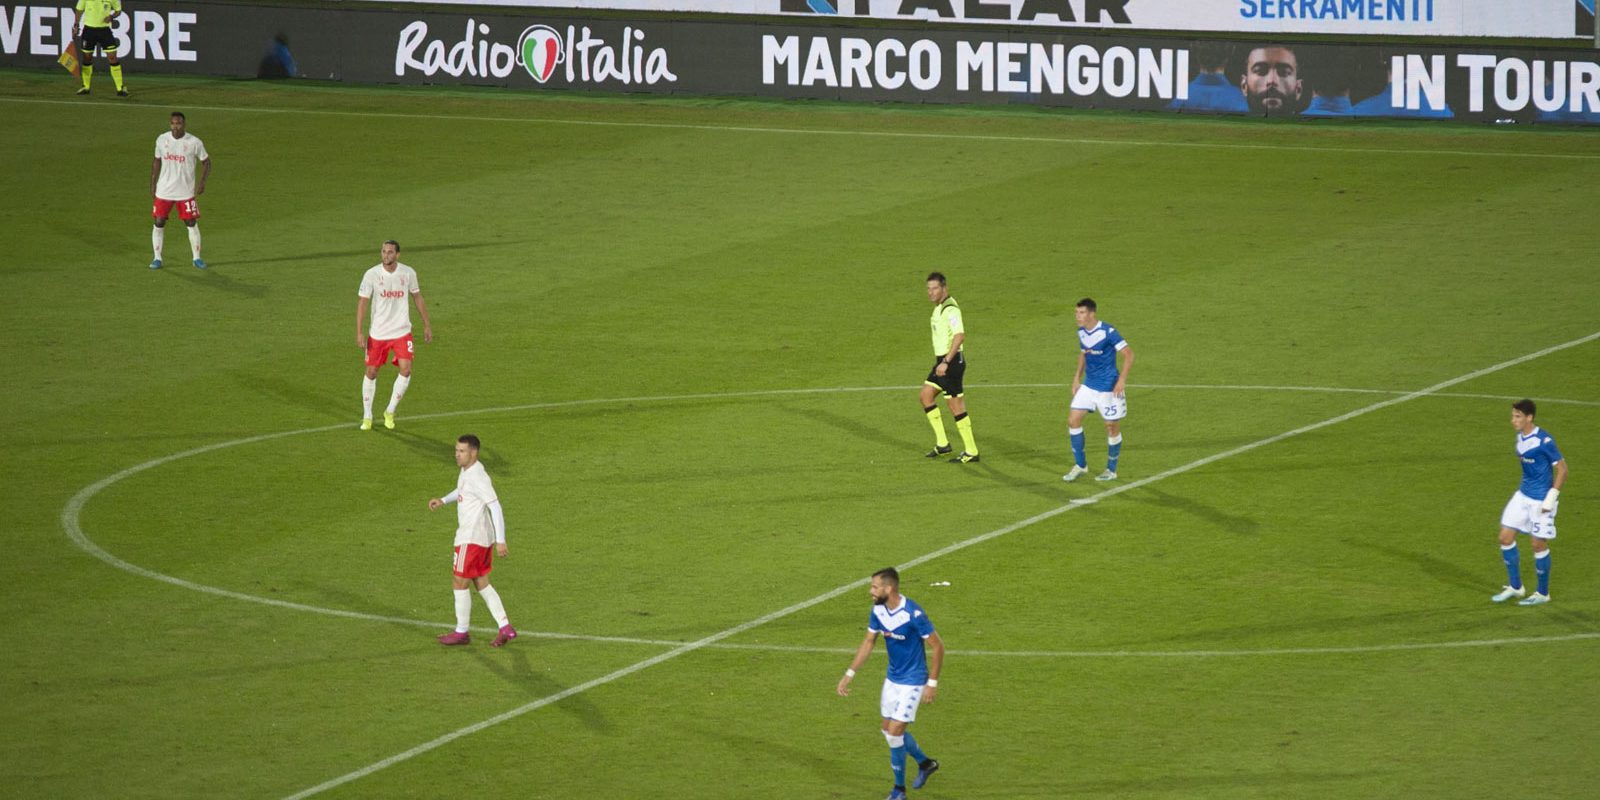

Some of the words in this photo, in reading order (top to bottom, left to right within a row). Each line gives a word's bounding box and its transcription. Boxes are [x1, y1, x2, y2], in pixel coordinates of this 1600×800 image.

[1240, 0, 1433, 21] SERRAMENTI
[395, 18, 515, 78] Radio
[565, 24, 677, 85] Italia
[762, 34, 941, 91] MARCO
[956, 40, 1189, 100] MENGONI
[1391, 54, 1445, 110] IN
[1457, 54, 1600, 114] TOUR
[164, 152, 185, 162] Jeep
[185, 201, 196, 213] 12
[380, 289, 404, 299] Jeep
[1104, 405, 1117, 417] 25
